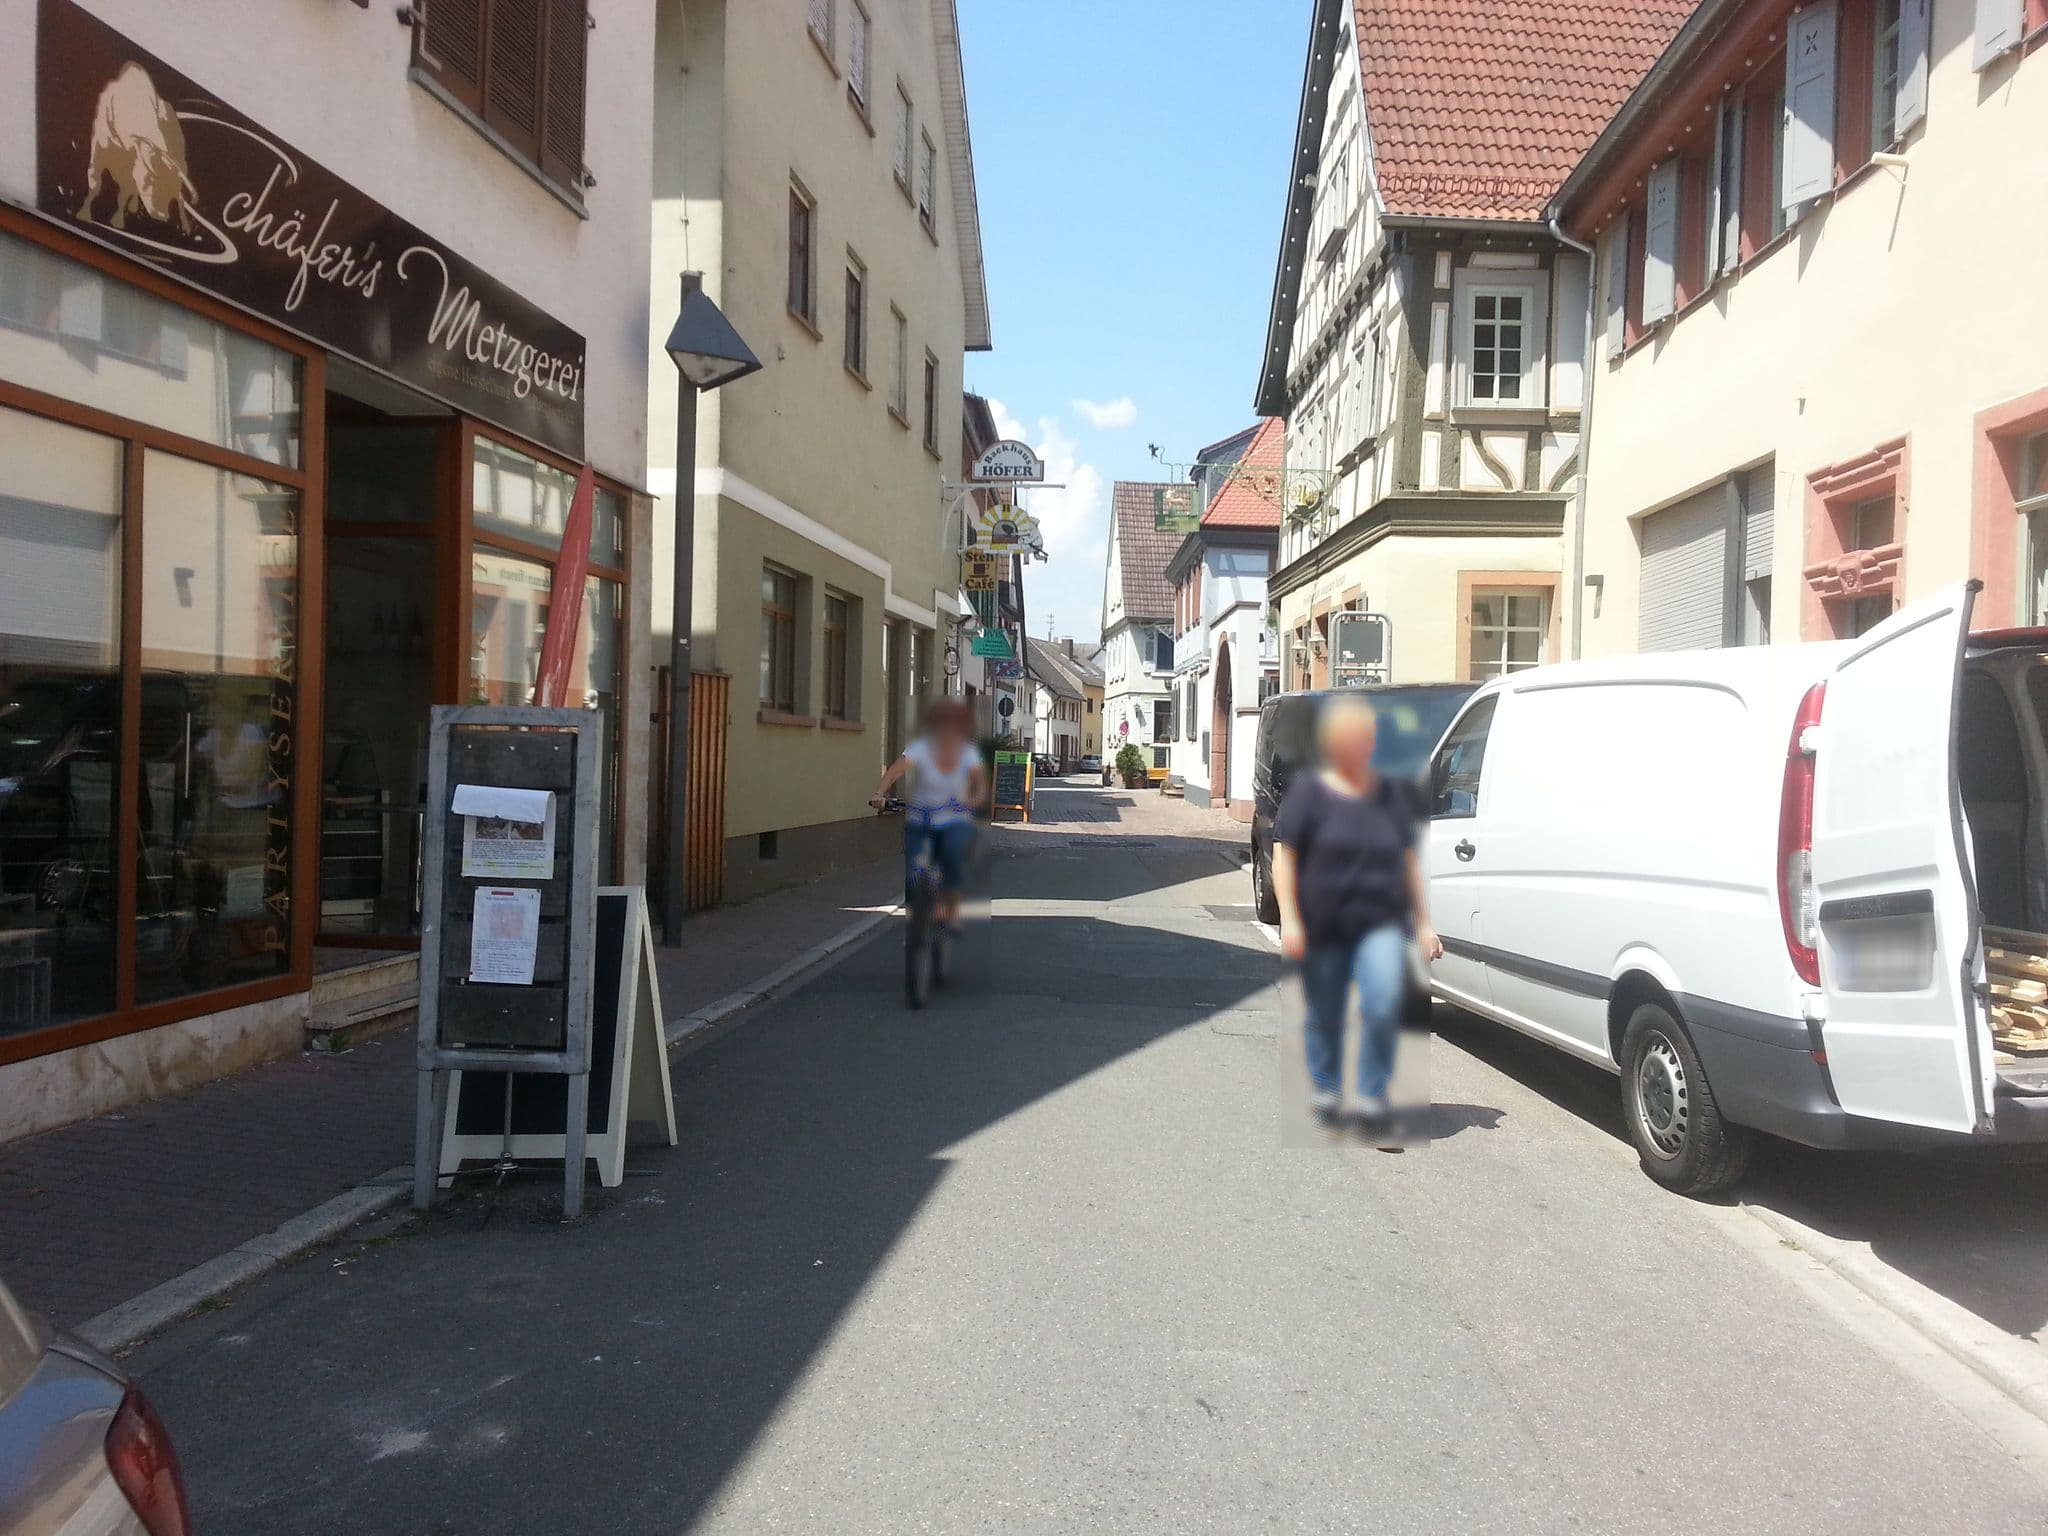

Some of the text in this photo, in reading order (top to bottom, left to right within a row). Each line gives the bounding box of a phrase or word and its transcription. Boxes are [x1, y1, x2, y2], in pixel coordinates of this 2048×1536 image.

[90, 111, 585, 402] Schäfer's Metzgerei
[984, 443, 1032, 465] Backhaus
[982, 463, 1033, 477] HÖFER
[965, 578, 995, 589] Café
